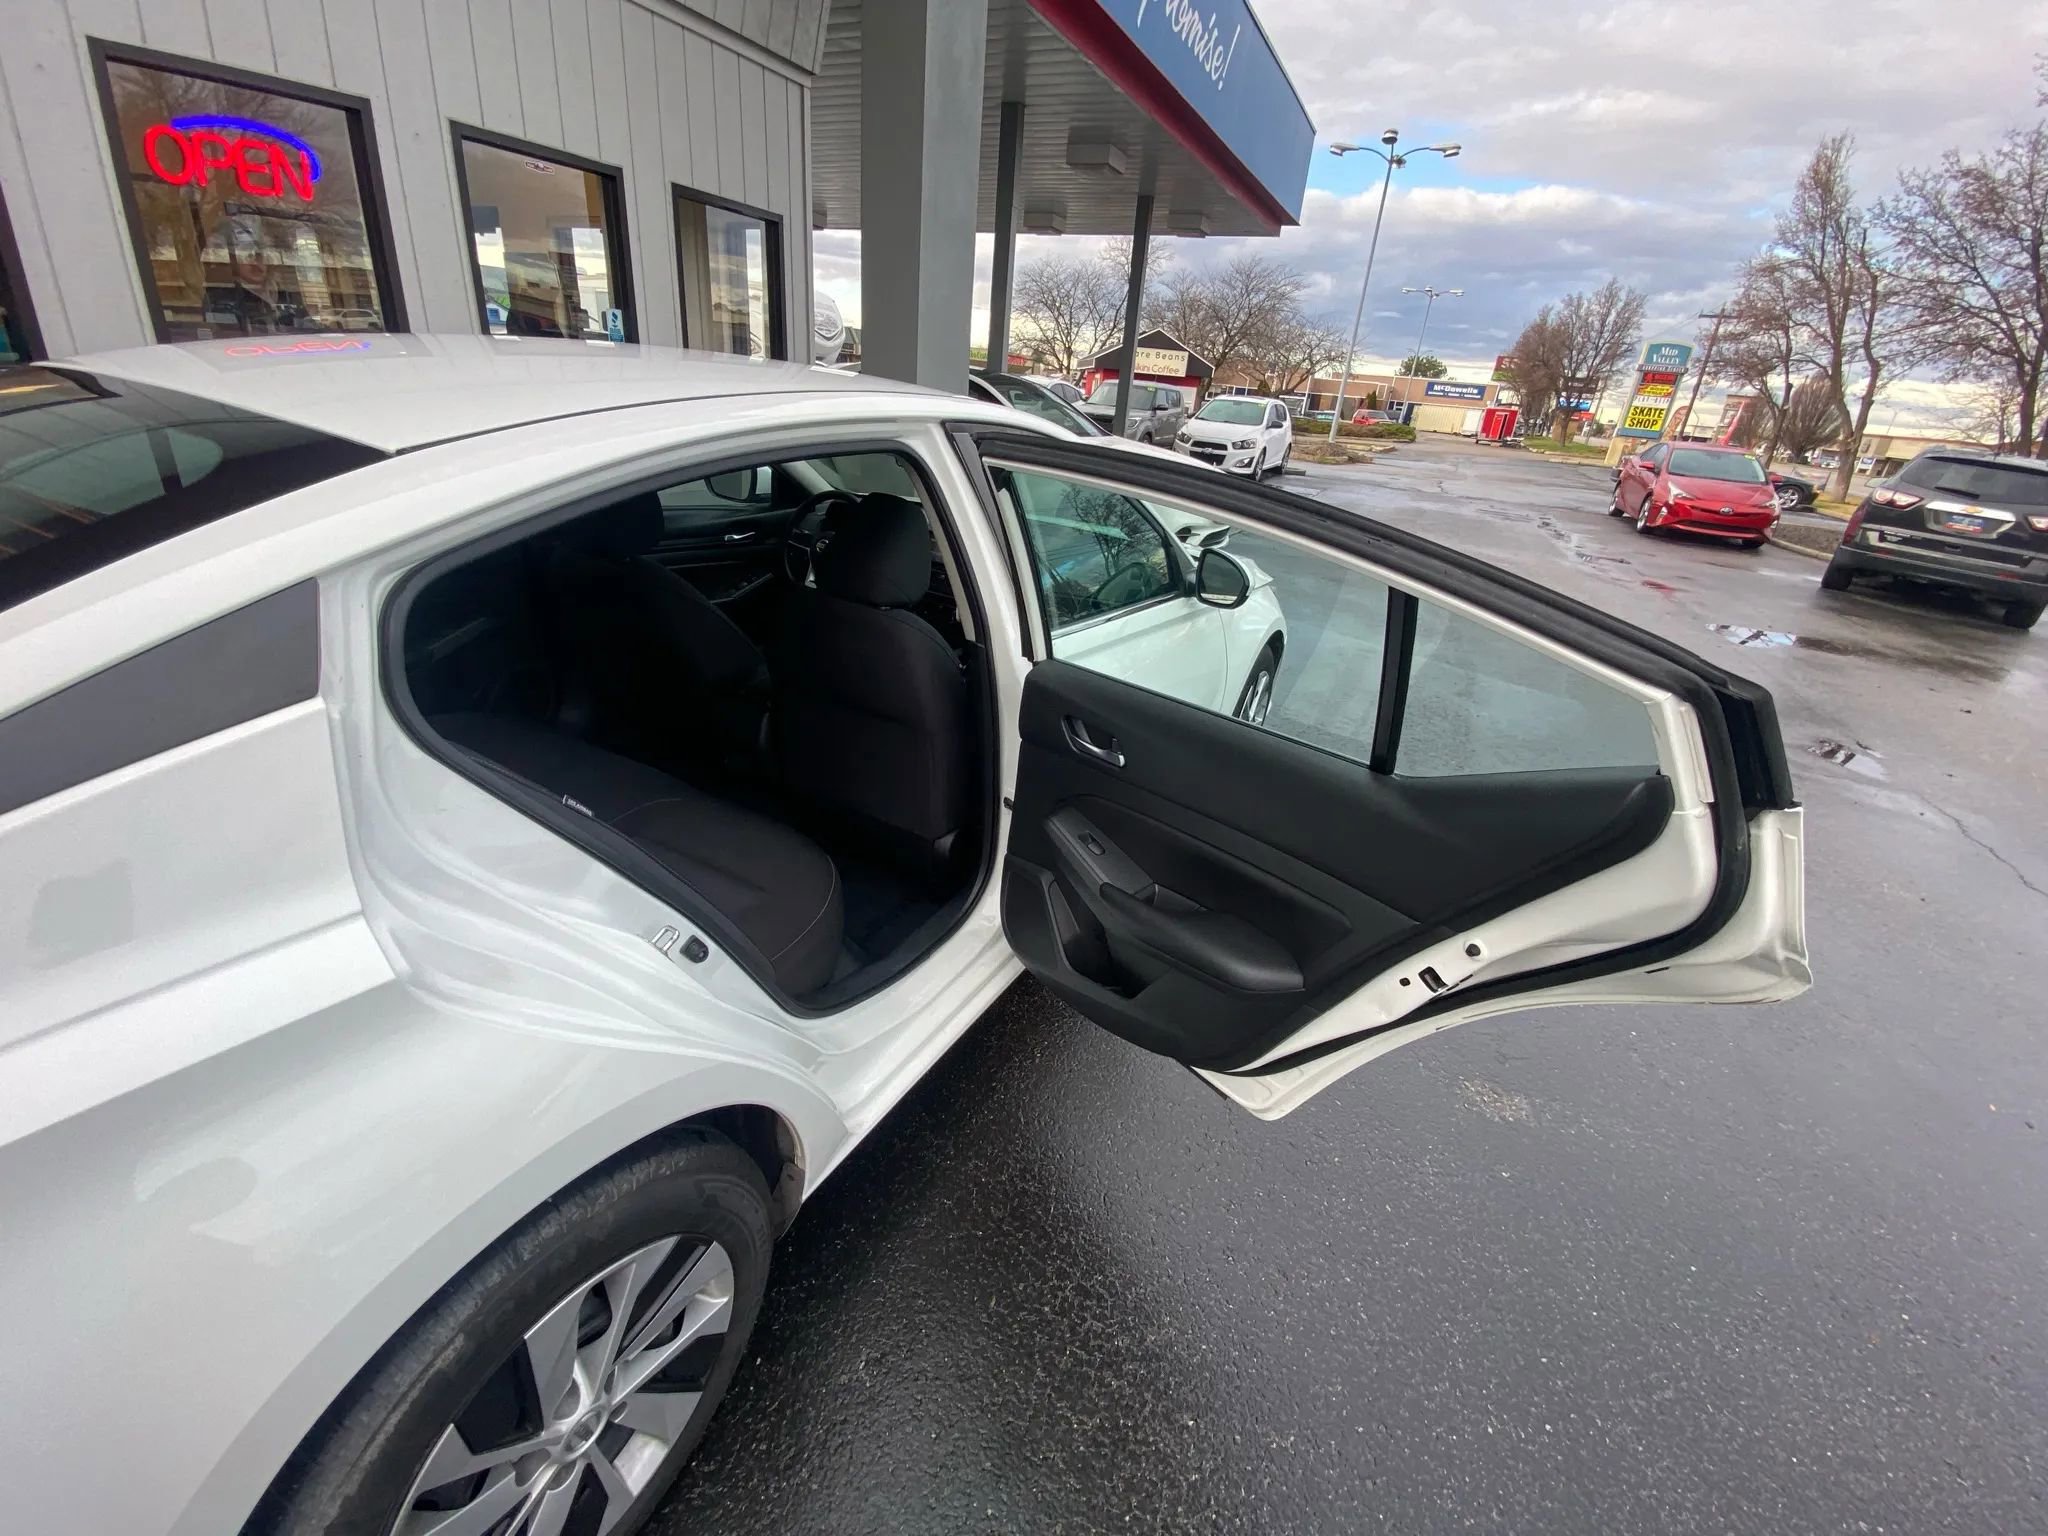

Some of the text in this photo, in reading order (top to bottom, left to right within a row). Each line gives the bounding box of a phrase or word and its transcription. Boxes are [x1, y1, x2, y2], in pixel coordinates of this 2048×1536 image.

[143, 124, 314, 201] OPEN
[1155, 351, 1186, 361] Beans
[1151, 364, 1180, 374] Coffee
[1631, 406, 1665, 418] SKATE
[1628, 417, 1658, 429] SHOP
